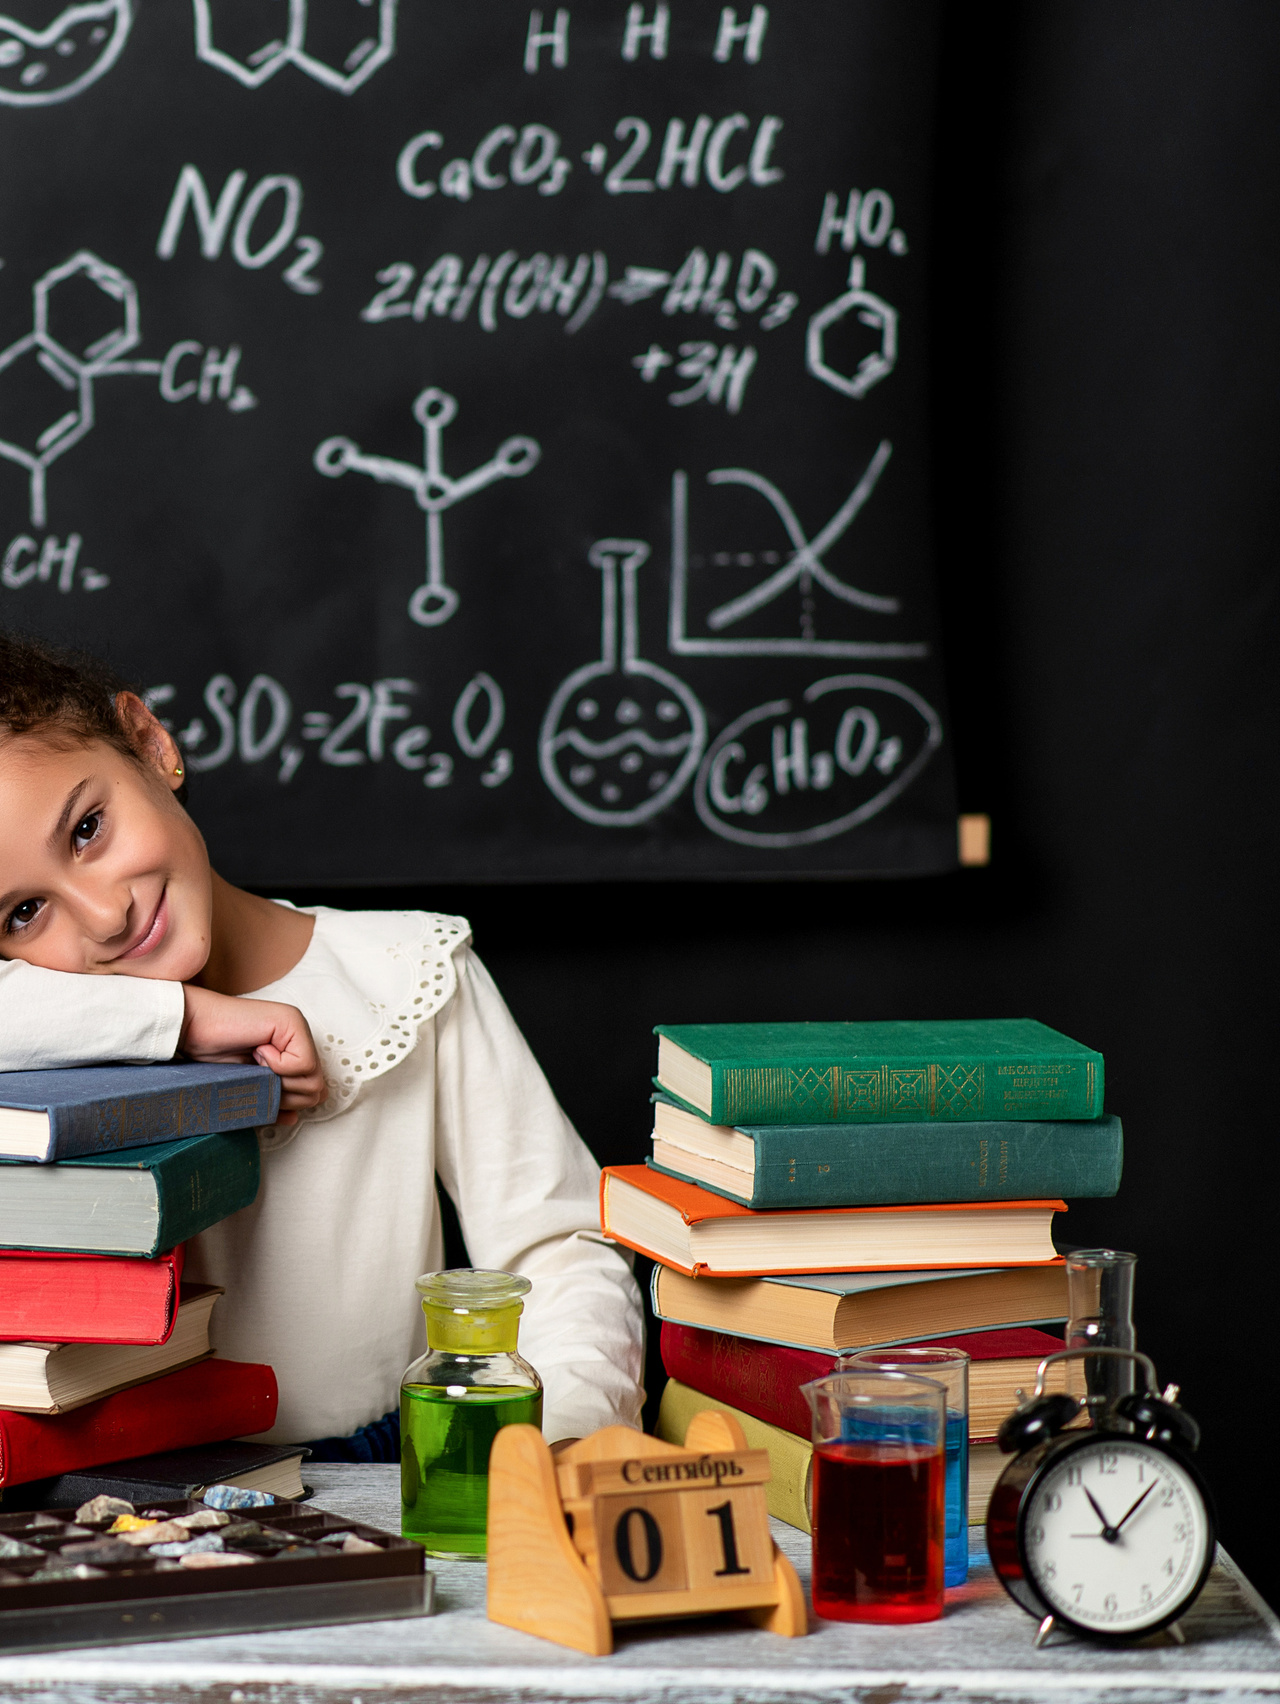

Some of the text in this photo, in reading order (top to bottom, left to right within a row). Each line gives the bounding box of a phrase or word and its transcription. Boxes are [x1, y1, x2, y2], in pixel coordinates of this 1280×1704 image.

[524, 3, 768, 73] H H H
[155, 162, 323, 296] NO2
[621, 1455, 745, 1487] Сентябрь
[1098, 1453, 1119, 1474] 12
[1138, 1463, 1145, 1483] 1
[1161, 1487, 1175, 1508] 2
[1032, 1526, 1046, 1546] 9
[1174, 1522, 1188, 1543] 3
[1043, 1561, 1058, 1579] 8
[1072, 1583, 1084, 1604] 7
[1140, 1583, 1153, 1604] 5
[1104, 1595, 1118, 1614] 6
